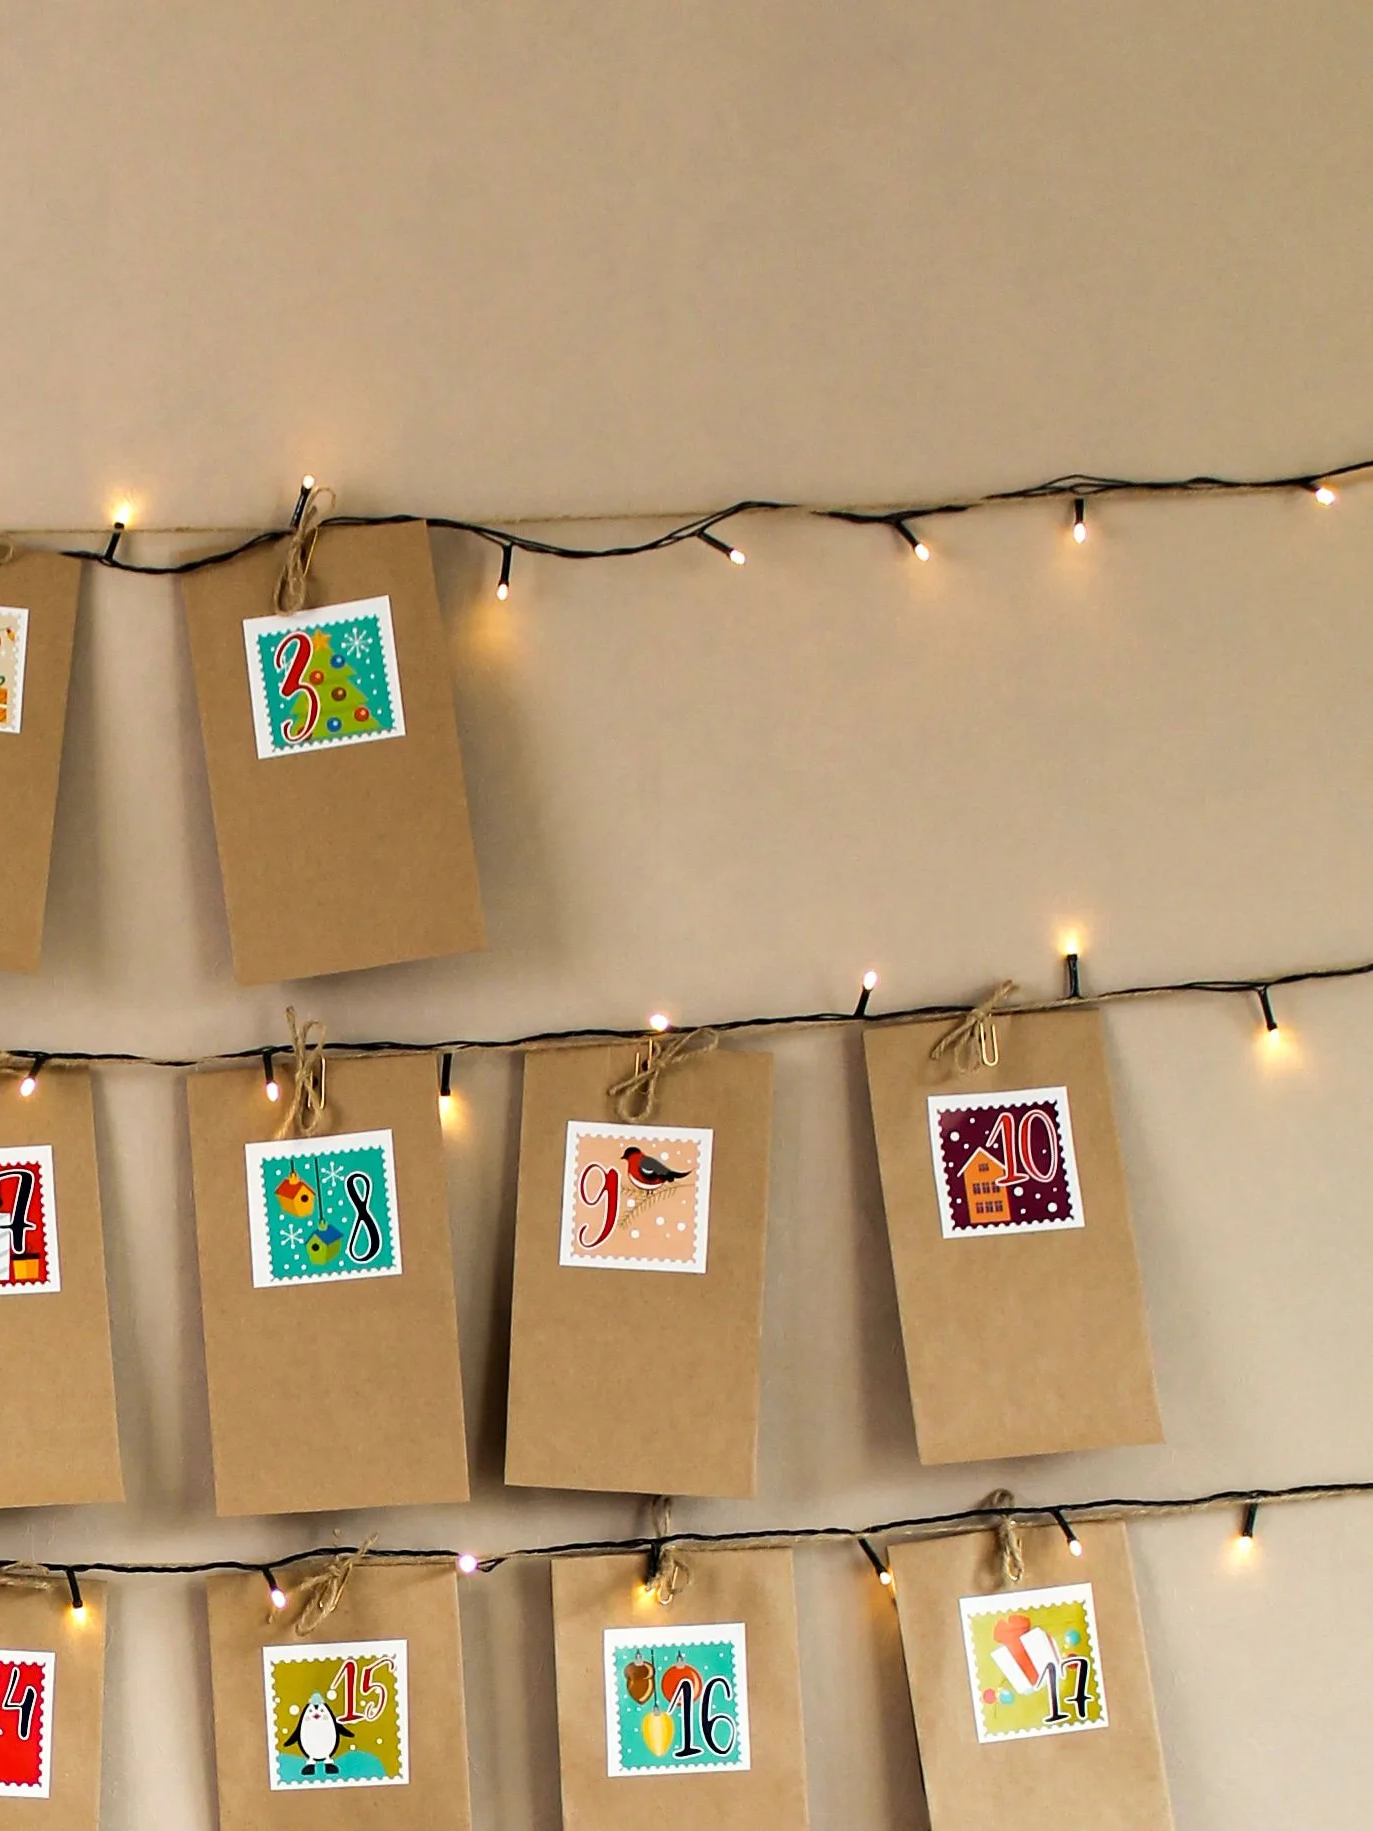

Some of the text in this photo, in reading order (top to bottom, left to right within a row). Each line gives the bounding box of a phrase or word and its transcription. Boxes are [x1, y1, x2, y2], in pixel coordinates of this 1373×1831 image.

[274, 632, 320, 741] 3
[985, 1109, 1059, 1185] 10
[345, 1171, 383, 1263] 8
[578, 1164, 620, 1248] 9
[330, 1658, 395, 1723] 15
[667, 1677, 736, 1758] 16
[1033, 1657, 1093, 1723] 17
